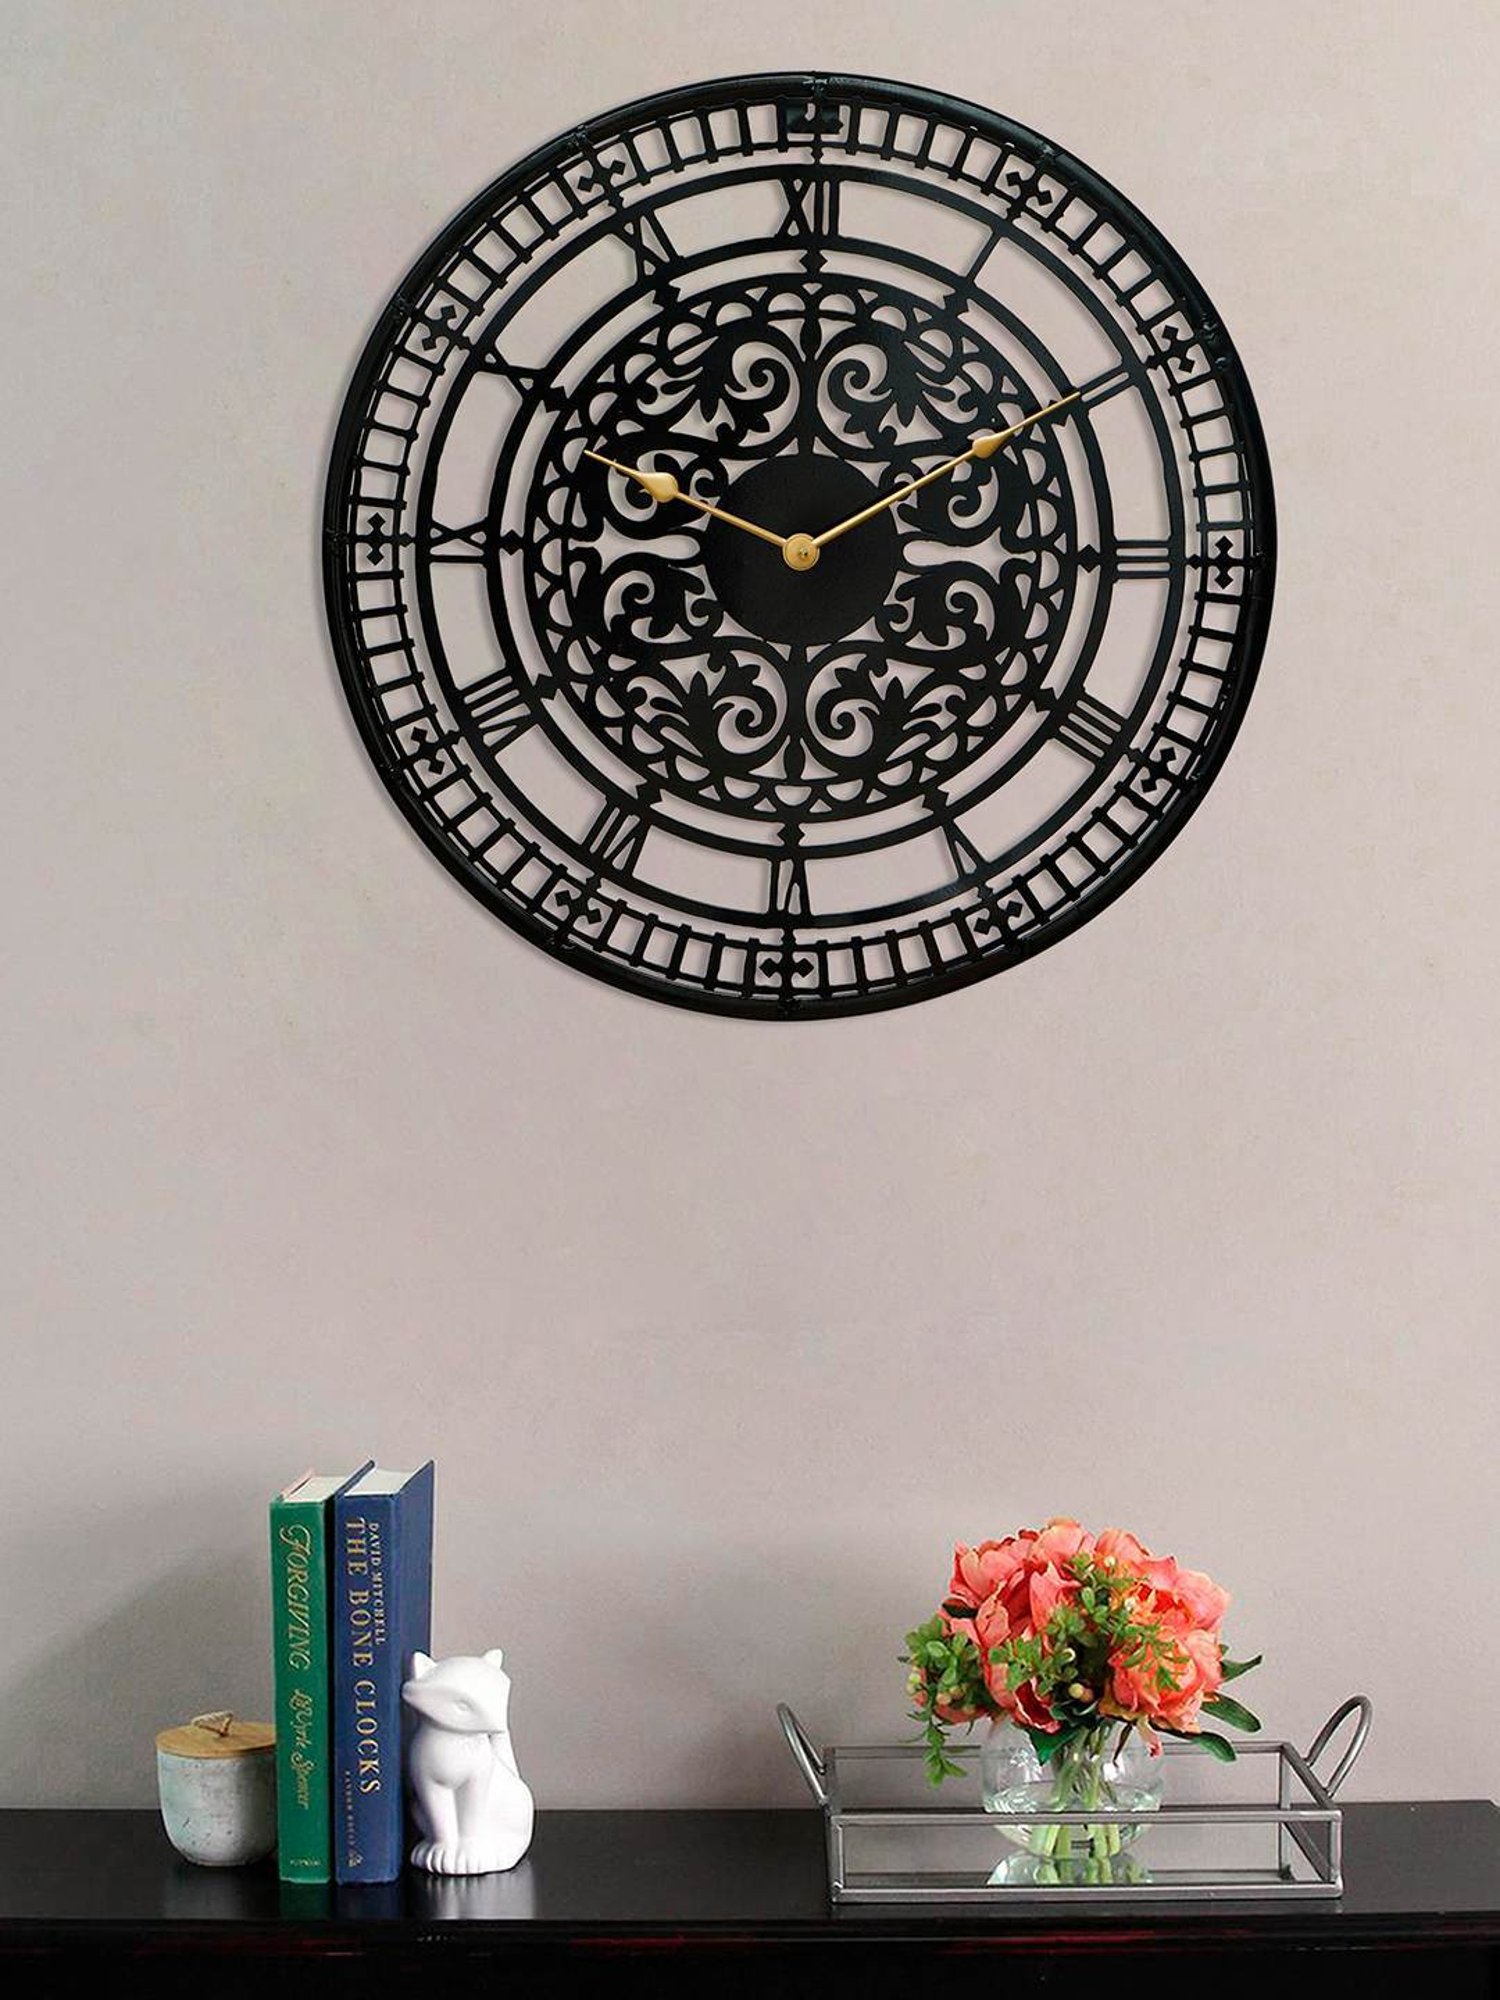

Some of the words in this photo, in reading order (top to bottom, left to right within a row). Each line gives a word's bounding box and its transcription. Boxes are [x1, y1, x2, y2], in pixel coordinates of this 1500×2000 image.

[775, 172, 842, 244] XII
[620, 209, 684, 283] XI
[427, 519, 489, 564] IX
[1112, 538, 1172, 579] III
[346, 1517, 368, 1576] THE
[369, 1522, 382, 1565] DAVID
[280, 1524, 313, 1671] FORGIVING
[349, 1590, 374, 1667] BONE
[373, 1570, 387, 1645] MITCHELL
[354, 1679, 381, 1794] CLOCKS
